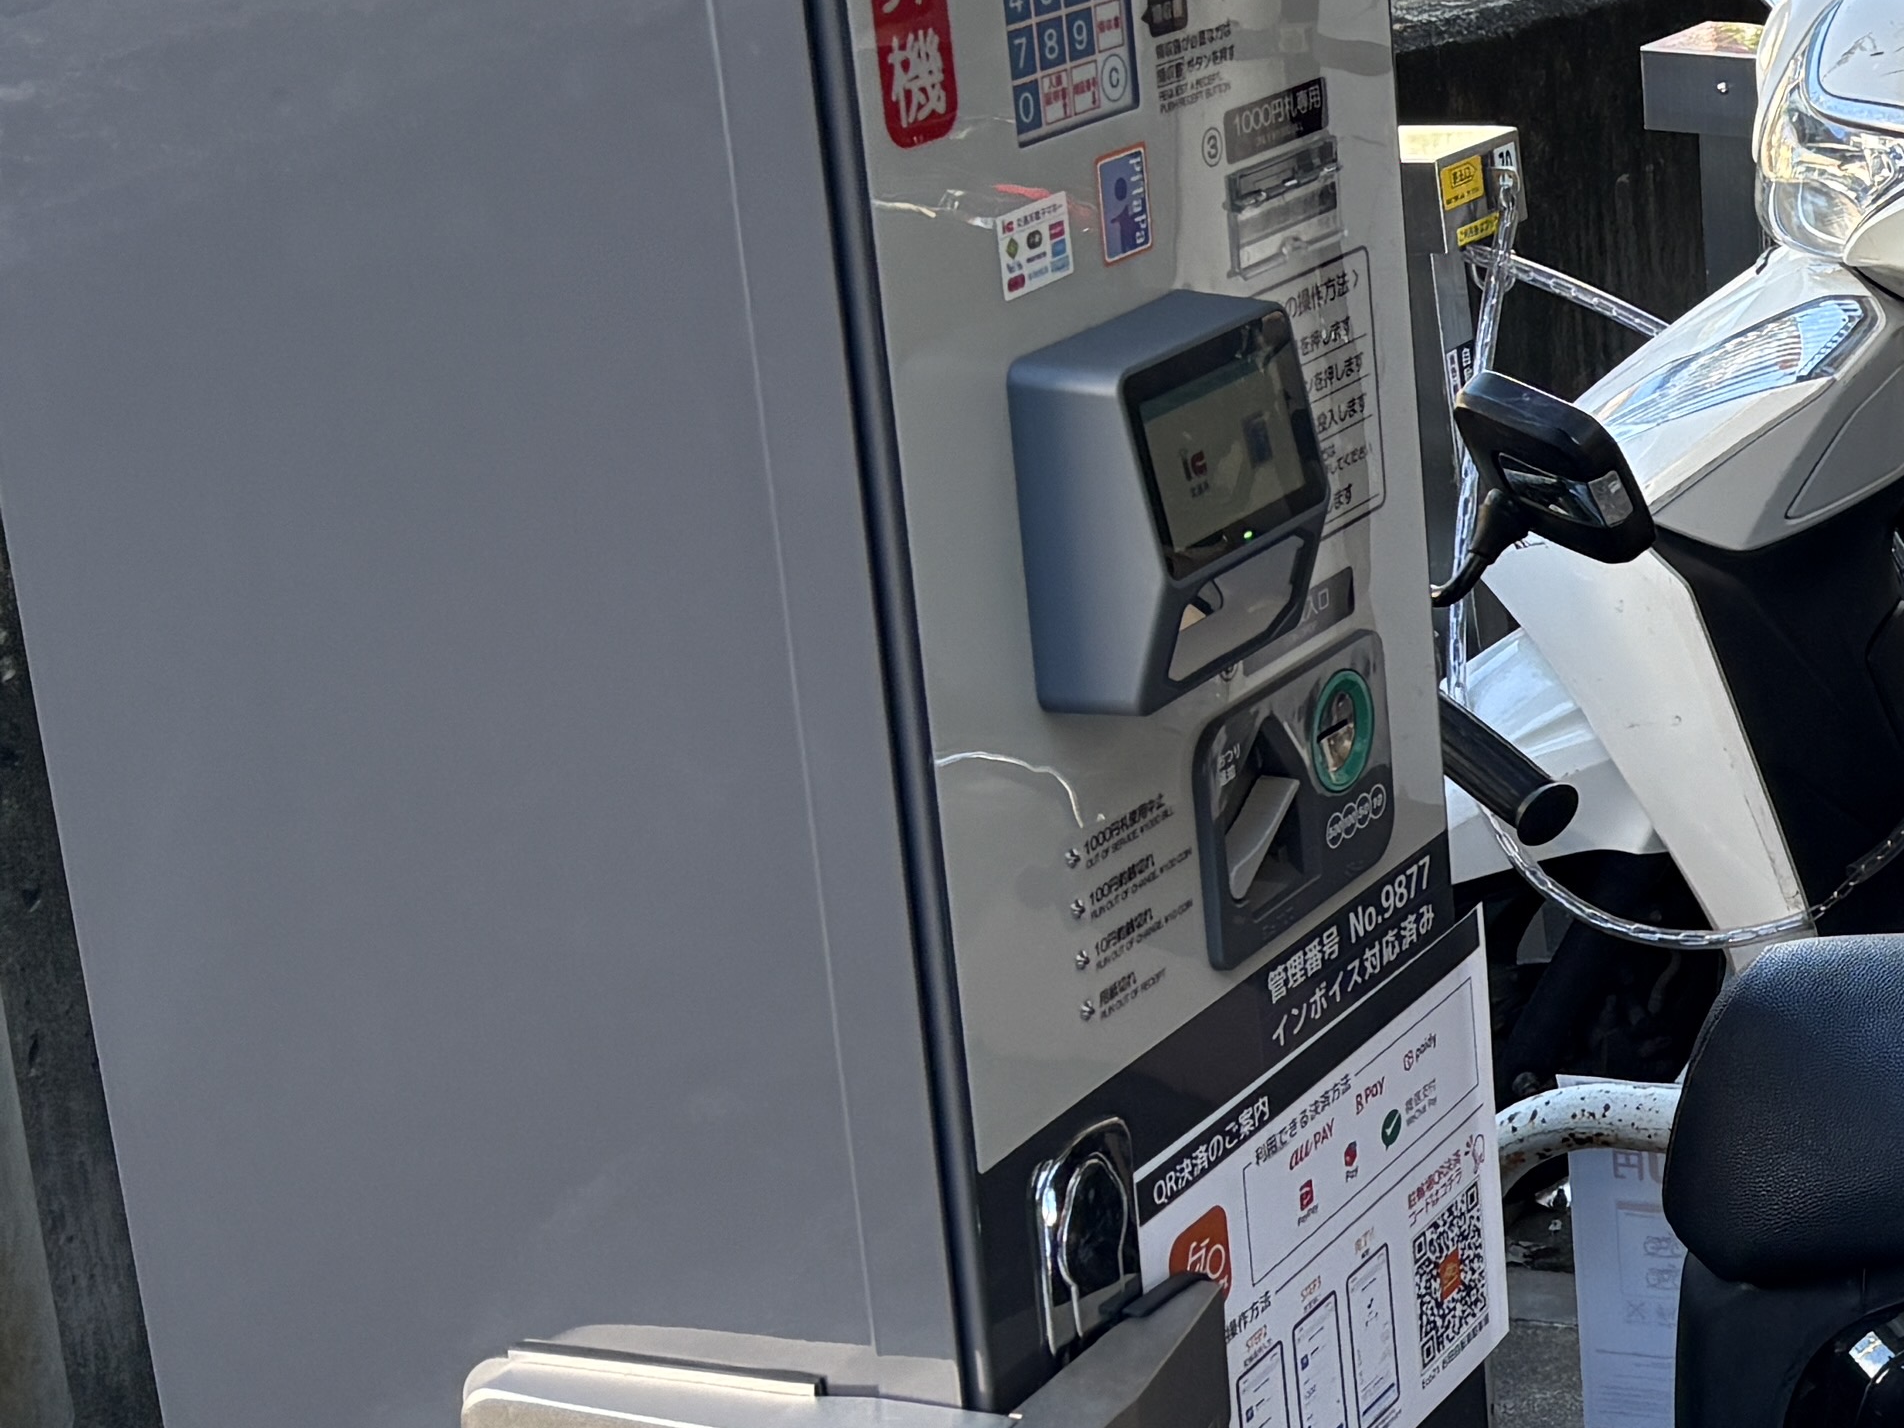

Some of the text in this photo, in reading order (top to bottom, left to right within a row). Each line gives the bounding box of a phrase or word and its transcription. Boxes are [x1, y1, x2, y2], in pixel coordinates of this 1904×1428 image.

[1013, 36, 1027, 69] 7
[1044, 28, 1059, 59] 8
[1072, 20, 1087, 50] 9
[1019, 92, 1034, 123] 0
[1233, 83, 1322, 137] 1000円札専用
[1268, 854, 1431, 1005] 管理番号 No.9877
[1271, 904, 1435, 1047] インボイス対応済み
[1153, 1095, 1271, 1205] QR決済のご案内
[1254, 1074, 1353, 1166] 利用できる決済方法
[1313, 1117, 1335, 1150] PAY
